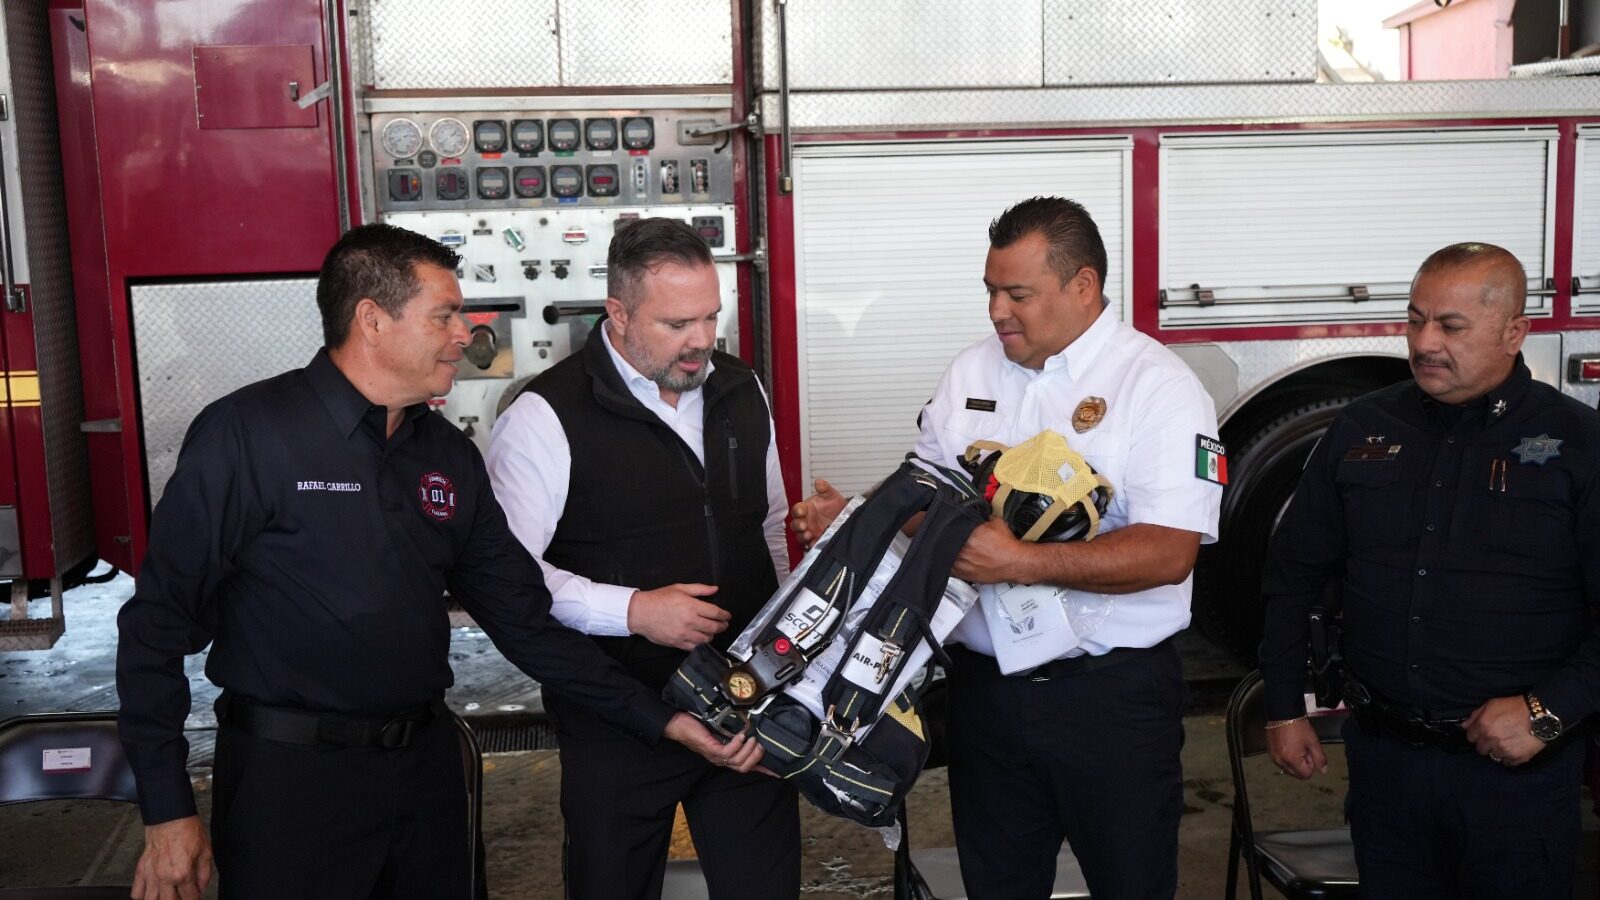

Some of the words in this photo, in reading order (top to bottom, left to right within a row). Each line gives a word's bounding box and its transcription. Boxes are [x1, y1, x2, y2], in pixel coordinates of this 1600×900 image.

[1200, 438, 1225, 455] MÉXICO
[297, 481, 326, 490] RAFAEL
[326, 482, 361, 492] CARRILLO
[431, 489, 445, 504] 01
[784, 612, 824, 640] SCOT
[852, 652, 894, 677] AIR-PK
